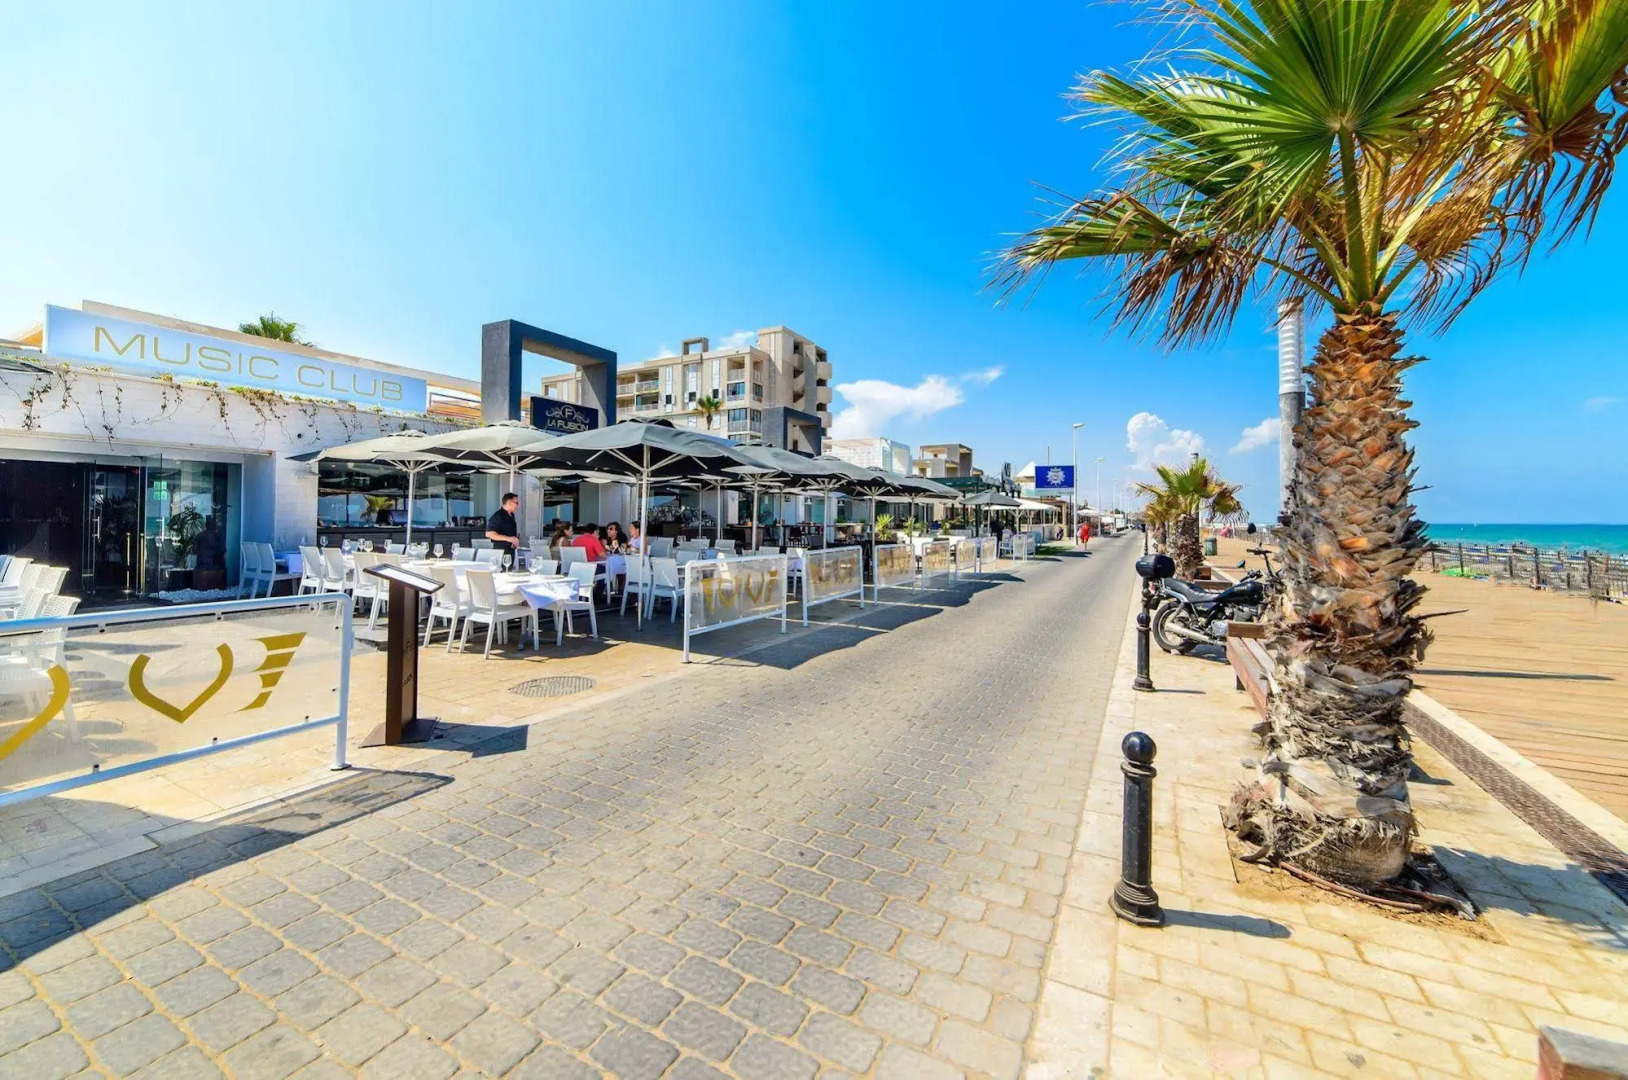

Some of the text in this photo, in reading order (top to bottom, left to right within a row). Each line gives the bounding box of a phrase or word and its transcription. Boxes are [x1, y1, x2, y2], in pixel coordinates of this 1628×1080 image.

[94, 326, 403, 401] MUSIC CLUB
[547, 419, 588, 431] LA FUSION
